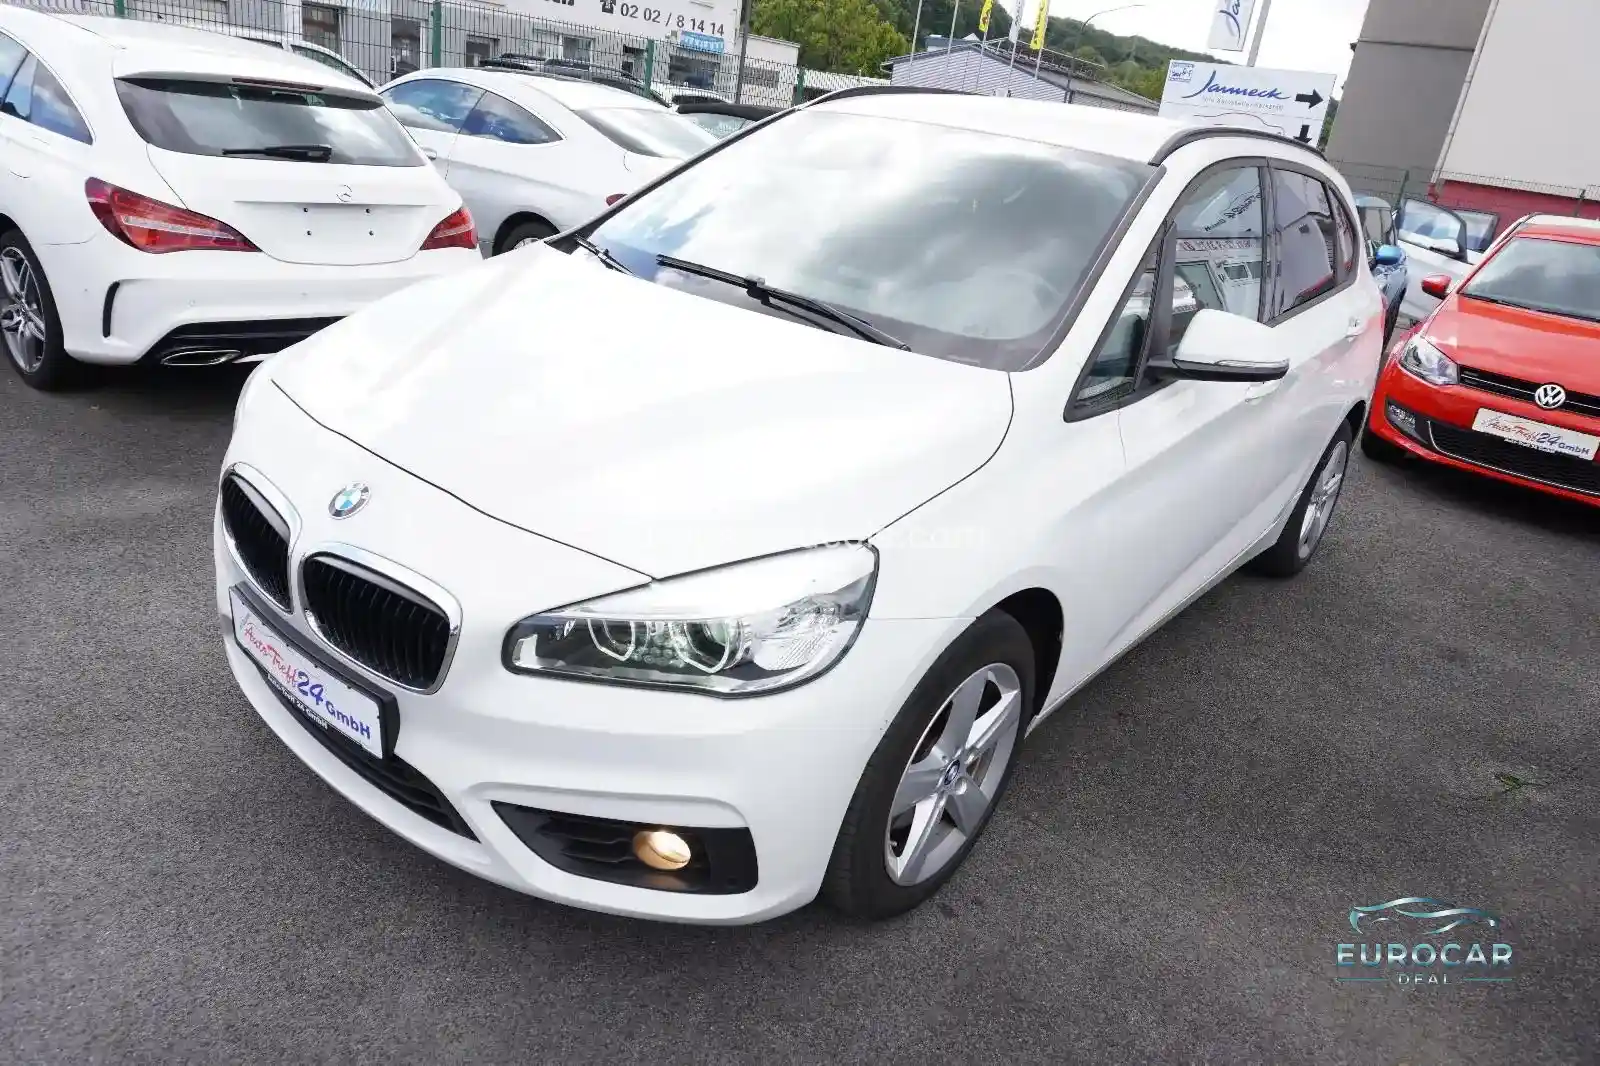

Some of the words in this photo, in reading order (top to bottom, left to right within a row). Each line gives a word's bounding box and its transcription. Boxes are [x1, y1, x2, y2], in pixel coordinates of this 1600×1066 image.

[620, 3, 639, 19] 02
[643, 7, 661, 24] 02
[676, 14, 685, 28] 8
[690, 18, 705, 33] 14
[710, 22, 725, 37] 14
[1558, 441, 1591, 456] GmbH
[325, 700, 371, 740] GmbH
